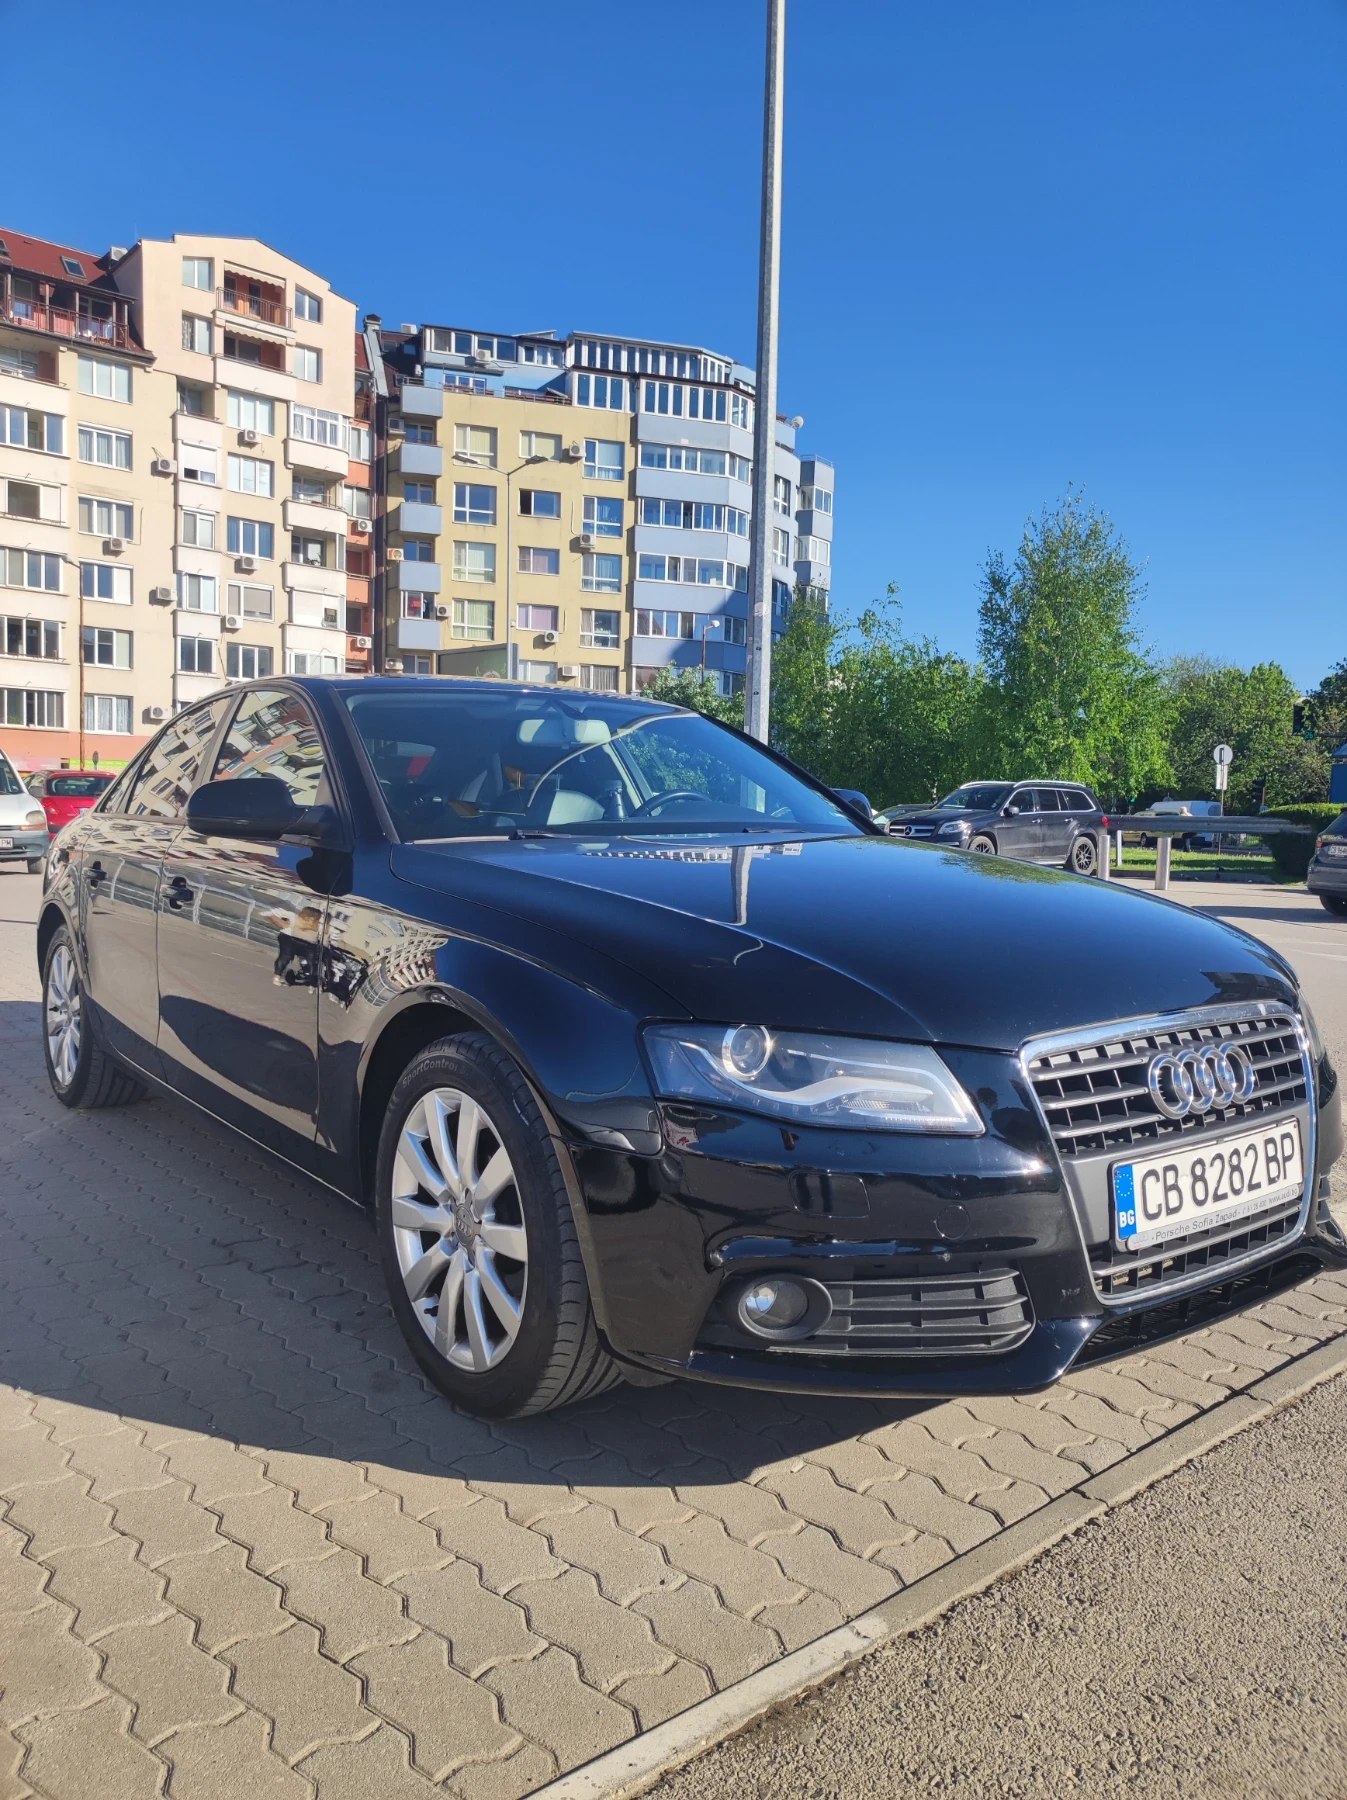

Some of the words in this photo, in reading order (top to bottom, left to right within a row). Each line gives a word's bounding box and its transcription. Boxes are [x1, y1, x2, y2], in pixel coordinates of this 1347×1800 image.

[1141, 1163, 1184, 1221] CB
[1191, 1143, 1262, 1207] 8282
[1264, 1132, 1295, 1186] BP
[1119, 1210, 1135, 1228] BG
[1155, 1223, 1190, 1240] Porsche
[1192, 1217, 1213, 1230] Sofia
[1215, 1210, 1238, 1225] Zapad
